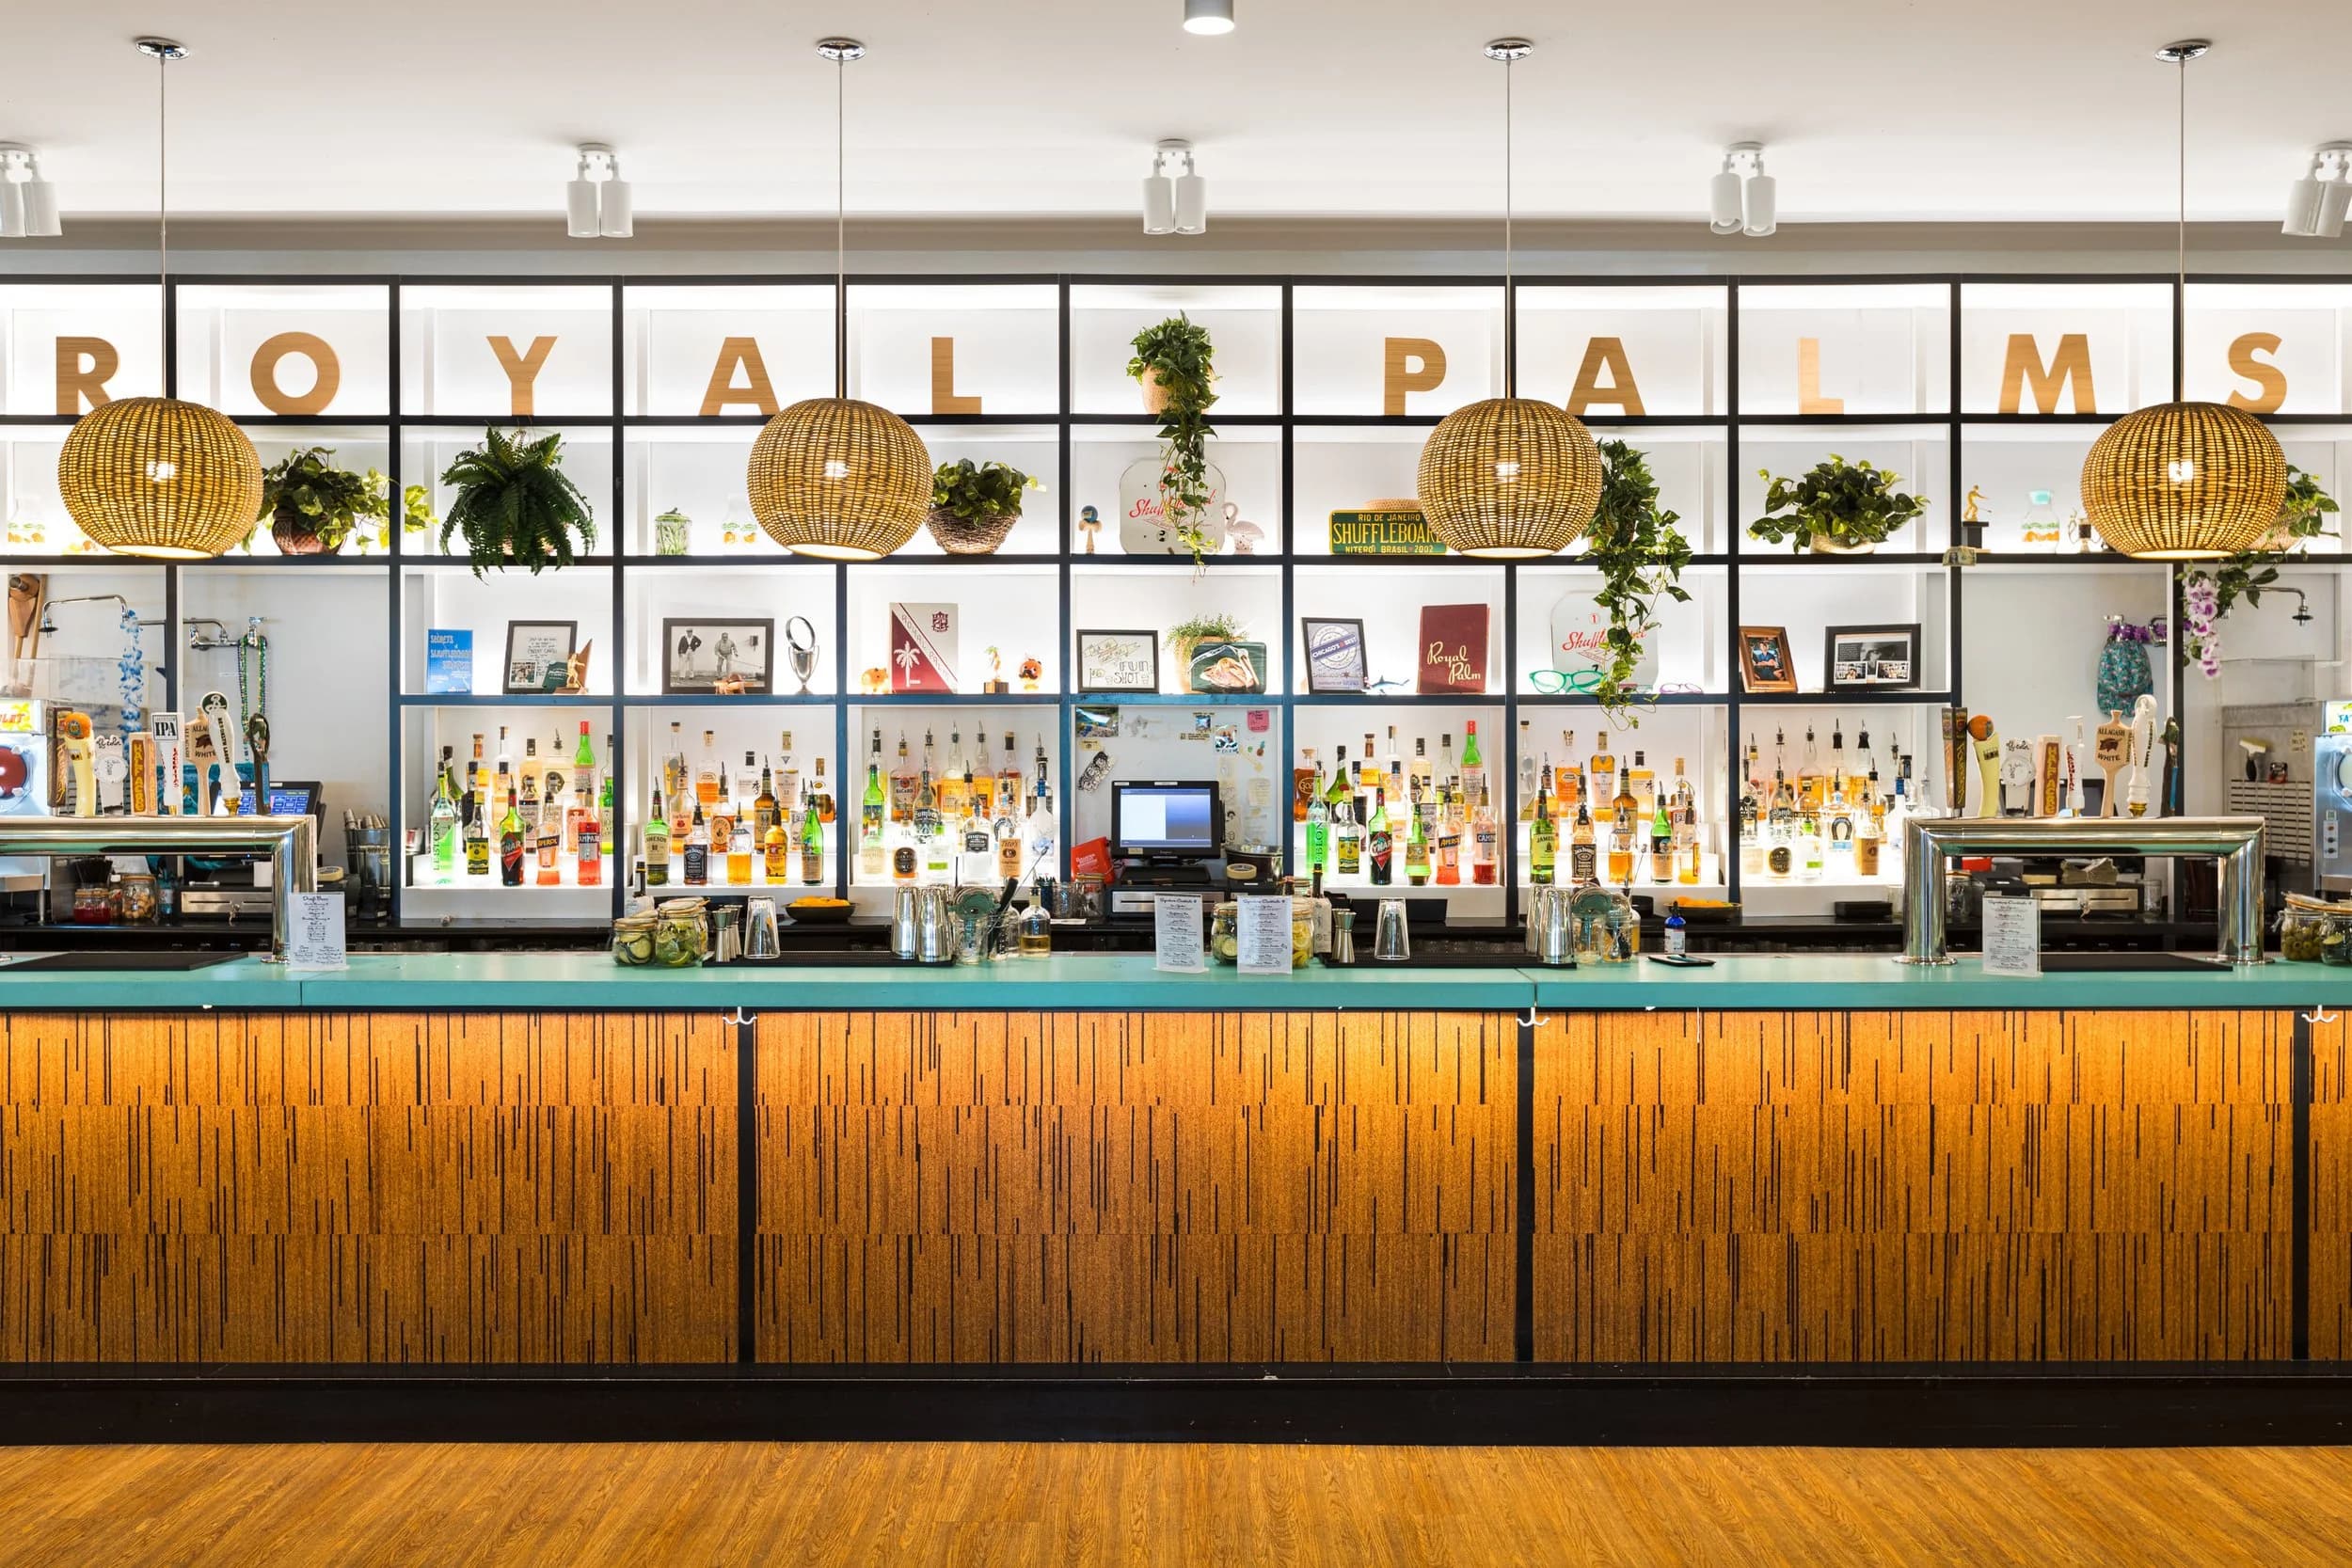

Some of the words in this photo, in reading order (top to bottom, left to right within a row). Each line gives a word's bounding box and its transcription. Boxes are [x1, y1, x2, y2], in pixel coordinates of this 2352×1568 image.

[56, 331, 982, 417] ROYAL
[1385, 331, 2288, 417] PALMS
[1427, 641, 1469, 668] Royal
[1449, 661, 1481, 685] Palm
[155, 721, 176, 736] IPA
[193, 724, 210, 733] ALLA
[2097, 727, 2126, 736] ALLAGASH
[2097, 752, 2121, 762] WHITE
